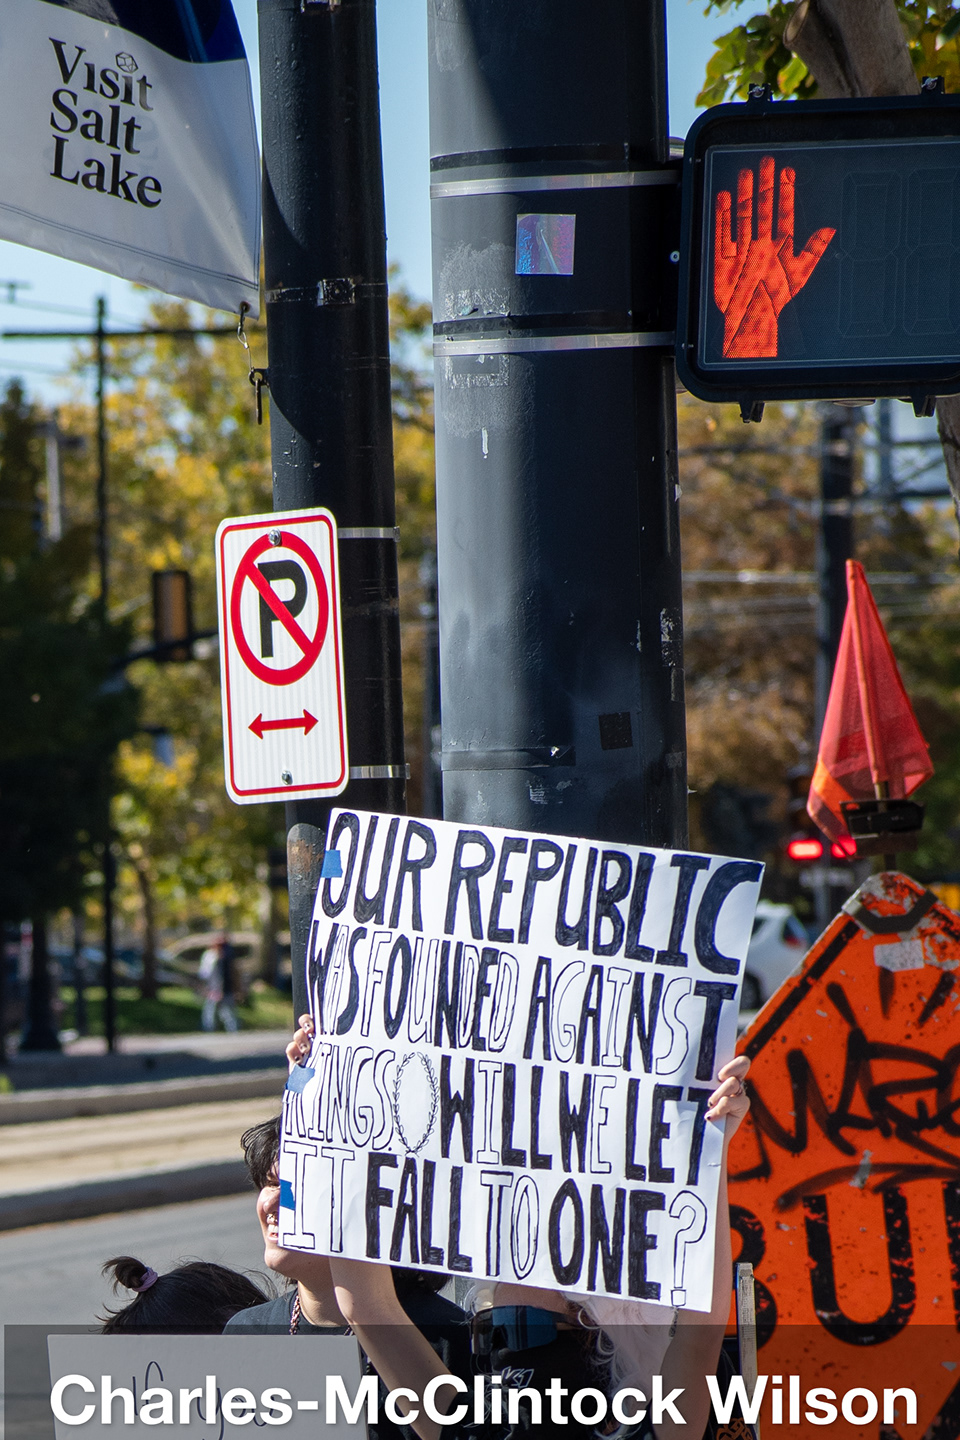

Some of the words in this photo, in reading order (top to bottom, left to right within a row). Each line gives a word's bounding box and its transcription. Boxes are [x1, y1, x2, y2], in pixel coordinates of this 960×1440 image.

[48, 37, 154, 111] Visit
[50, 88, 142, 155] Salt
[49, 134, 162, 208] Lake
[321, 811, 437, 932] OUR
[443, 829, 765, 976] REPUBLIC
[308, 920, 368, 1036] WAS
[360, 930, 521, 1053] FOUNDED
[522, 955, 738, 1081] AGAINST
[440, 1054, 553, 1170] WILL
[559, 1070, 617, 1174] WE
[625, 1077, 717, 1186] LET
[283, 1139, 355, 1253] IT
[365, 1151, 473, 1273] FALL
[480, 1169, 540, 1281] TO
[548, 1177, 708, 1307] ONE?
